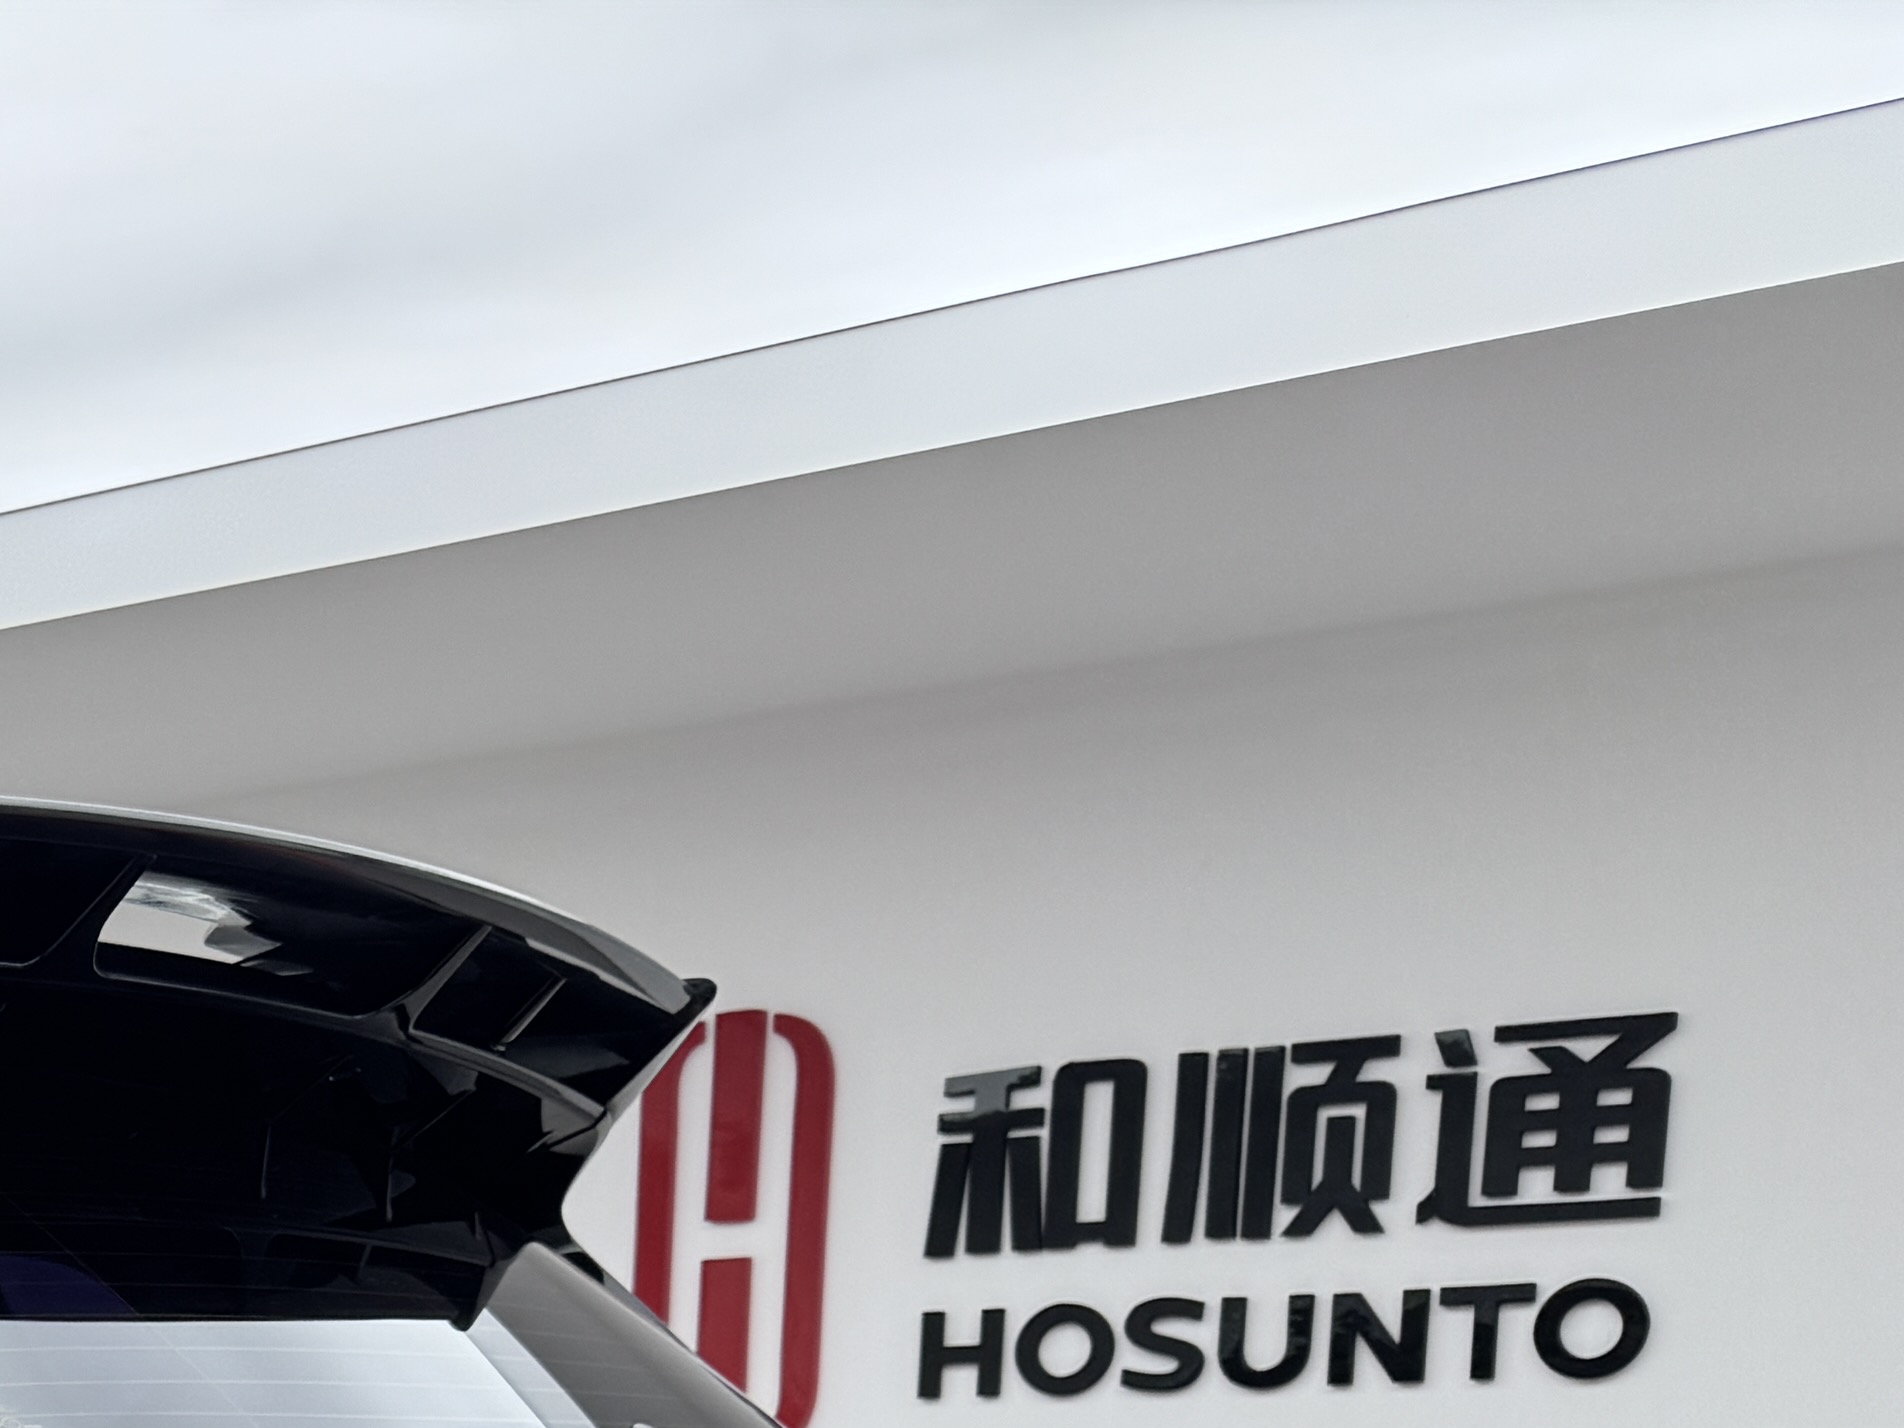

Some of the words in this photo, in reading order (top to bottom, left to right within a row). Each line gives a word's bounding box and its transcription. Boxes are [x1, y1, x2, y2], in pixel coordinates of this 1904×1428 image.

[921, 1010, 1679, 1260] 和顺通
[918, 1277, 1650, 1400] HOSUNTO
